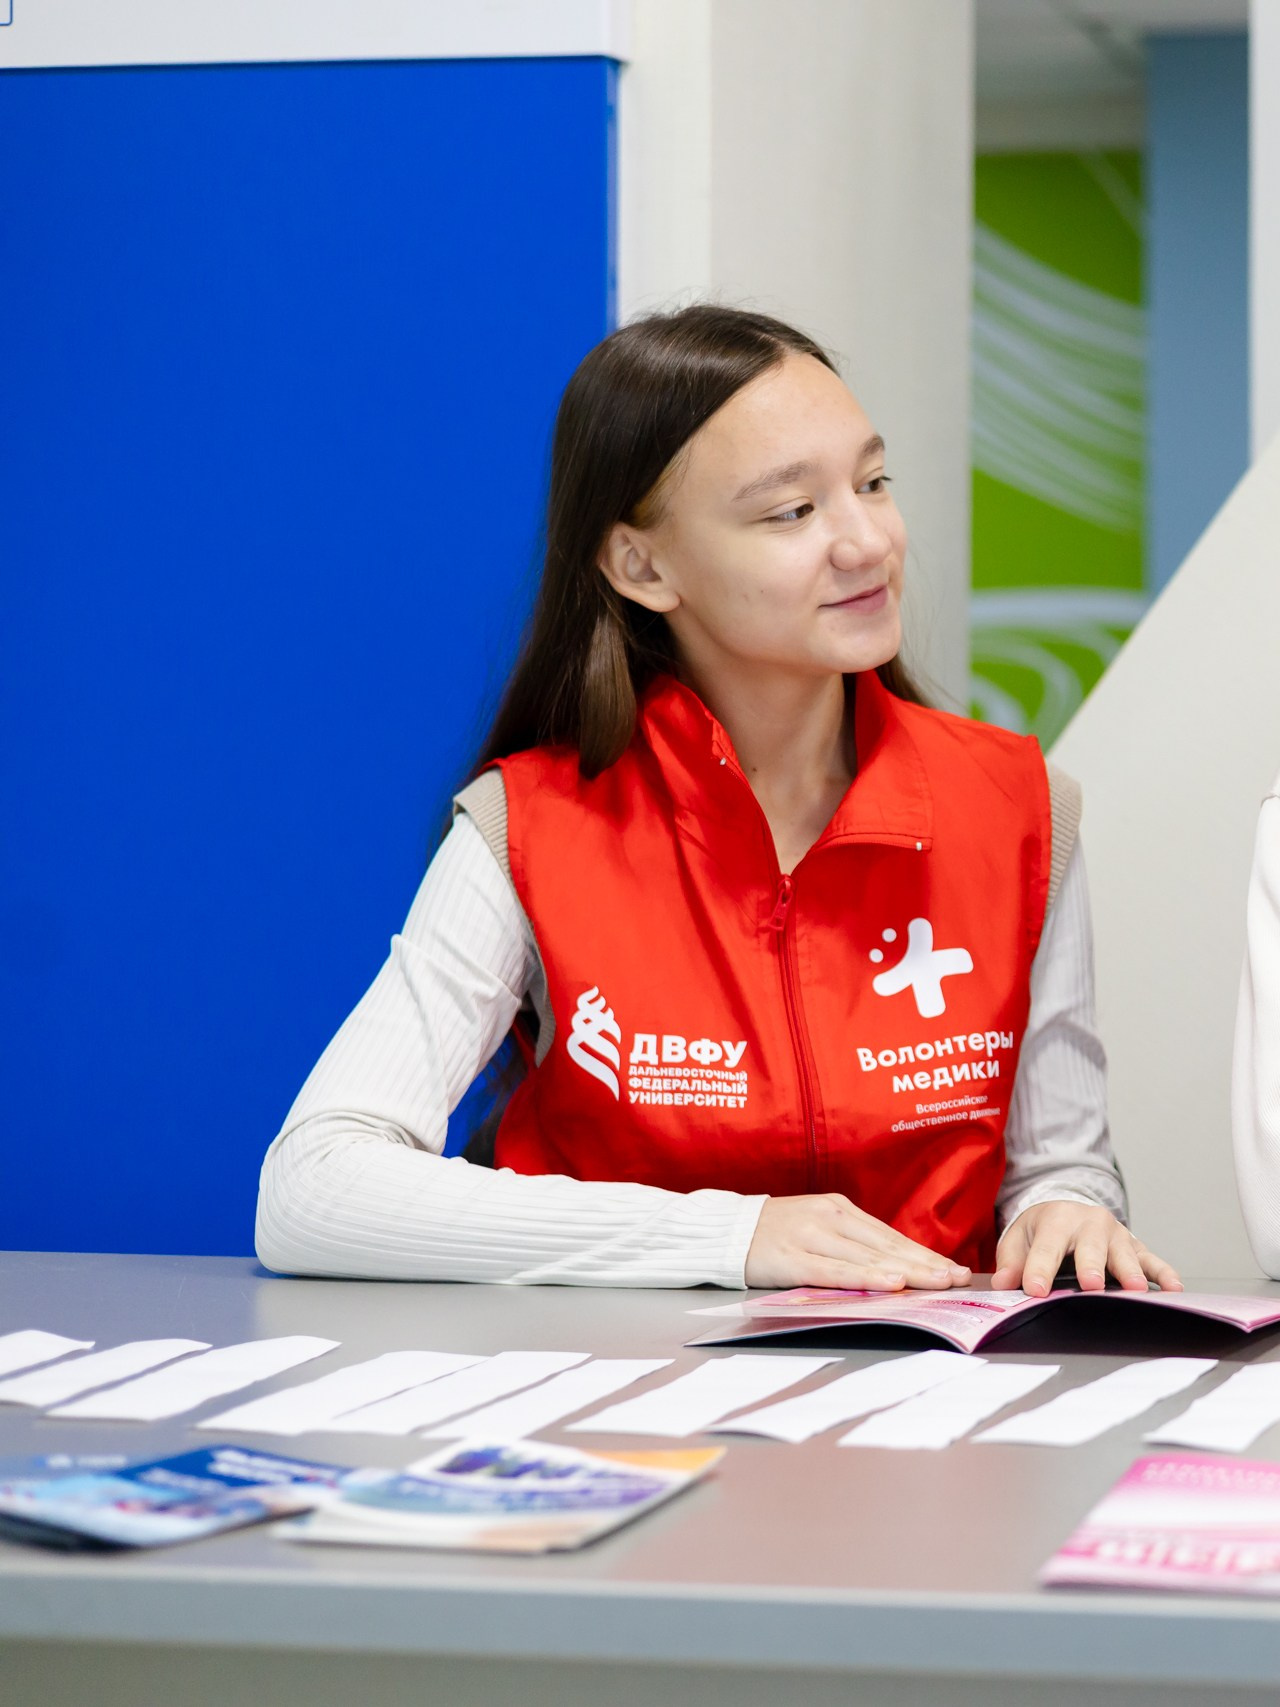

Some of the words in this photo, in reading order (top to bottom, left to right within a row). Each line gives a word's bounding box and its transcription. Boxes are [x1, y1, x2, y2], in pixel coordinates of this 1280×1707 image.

[629, 1033, 748, 1068] ДВФУ
[856, 1030, 1014, 1072] Волонтеры
[628, 1065, 748, 1082] ДАЛЬНЕВОСТОЧНЫЙ
[892, 1060, 1000, 1093] медики
[628, 1077, 748, 1095] ФЕДЕРАЛЬНЫЙ
[628, 1090, 748, 1109] УНИВЕРСИТЕТ
[915, 1095, 988, 1115] Всероссийское
[891, 1112, 969, 1133] общественное
